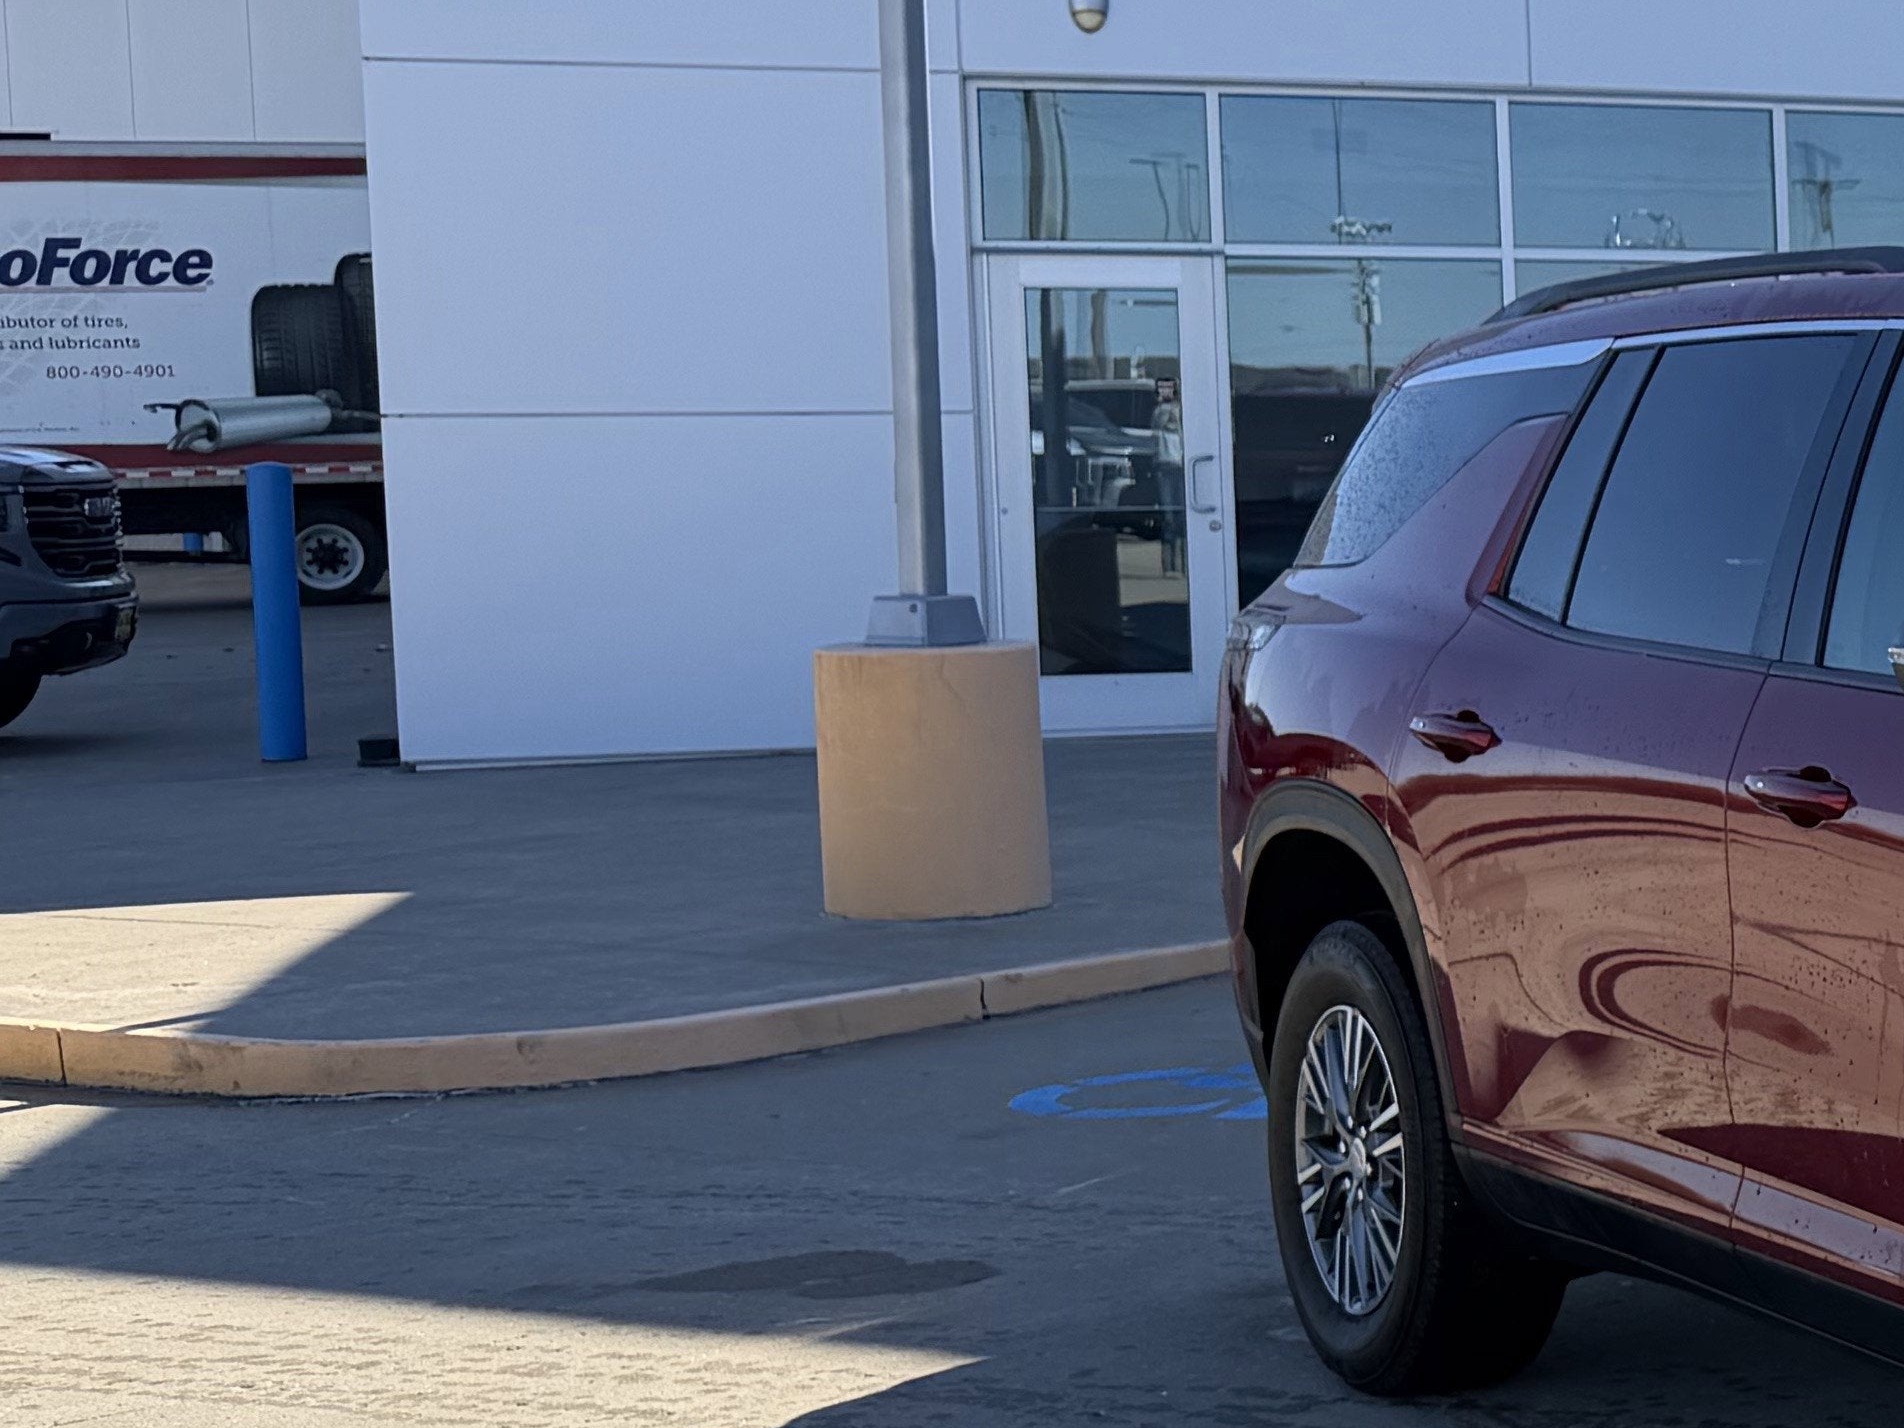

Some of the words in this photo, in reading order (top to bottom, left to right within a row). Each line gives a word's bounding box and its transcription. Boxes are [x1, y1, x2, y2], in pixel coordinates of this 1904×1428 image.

[0, 237, 213, 286] oForce
[61, 315, 79, 329] of
[84, 315, 128, 330] tires,
[9, 336, 44, 350] and
[49, 336, 141, 350] lubricants
[46, 363, 176, 380] 800-490-4901
